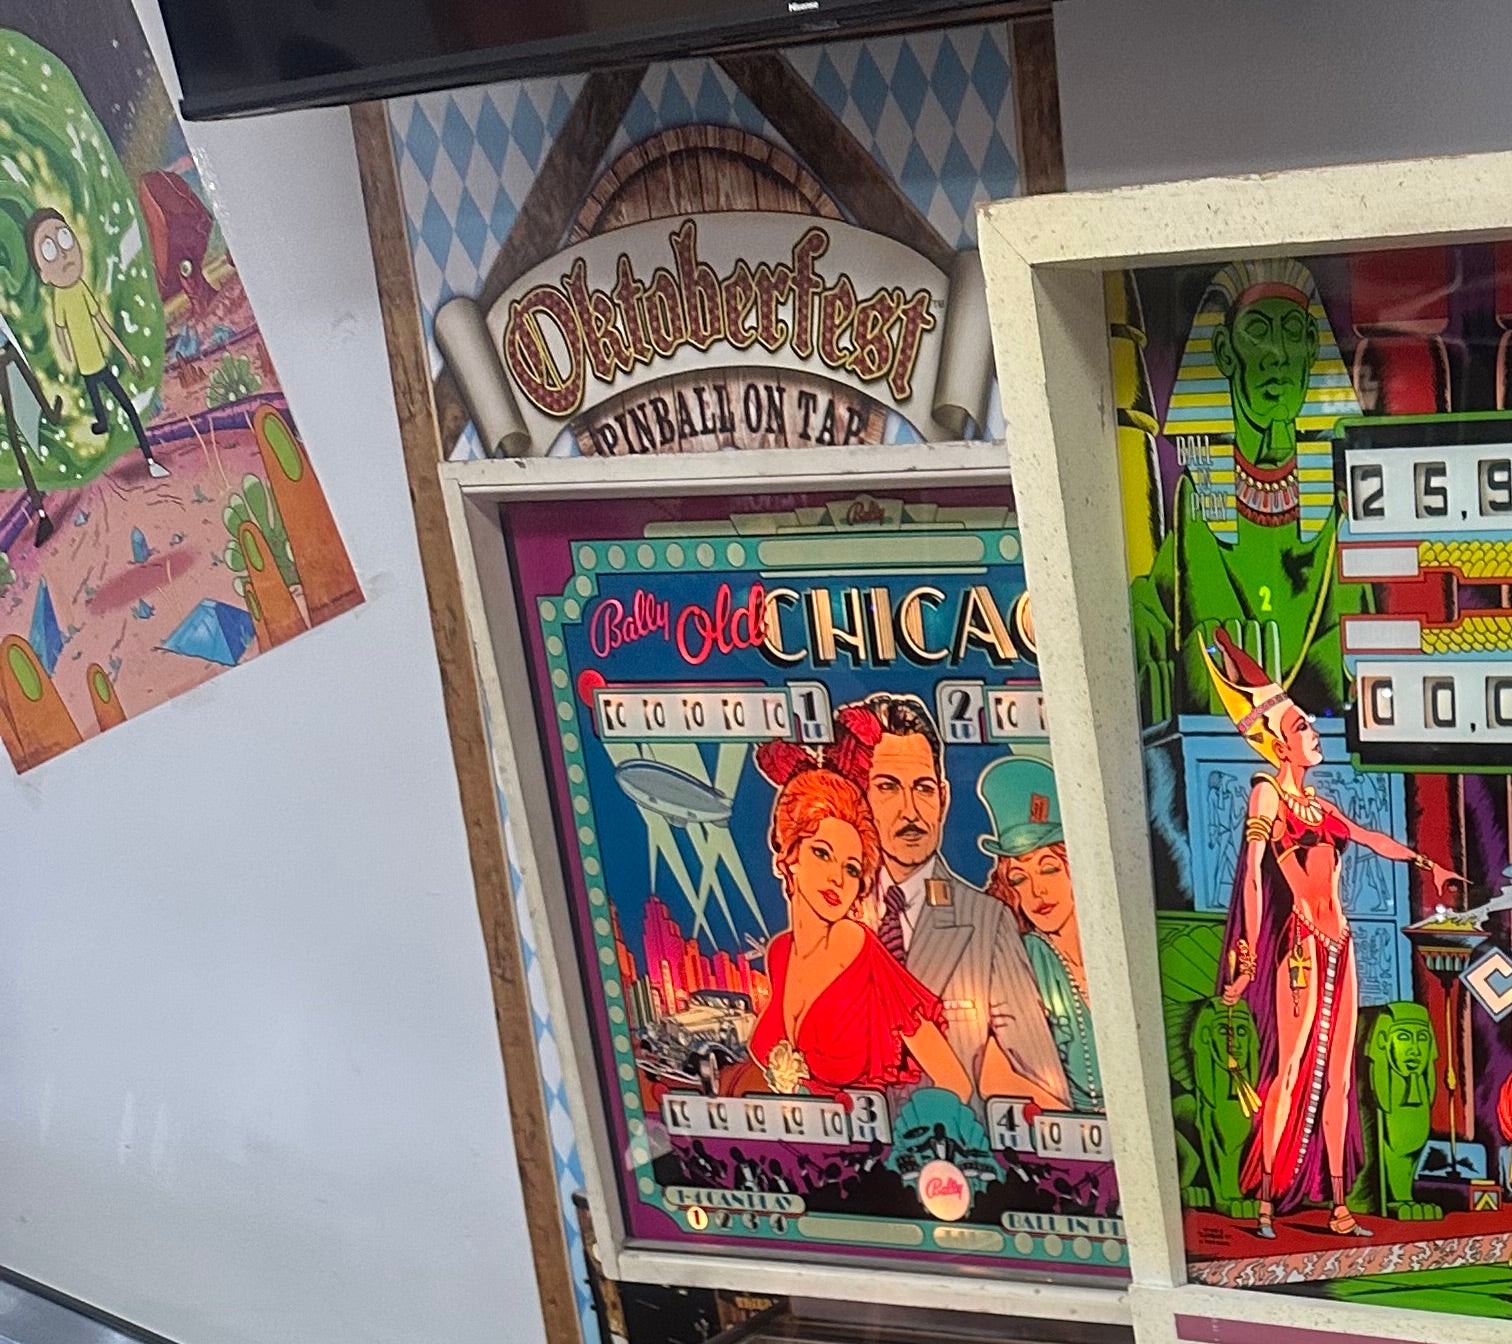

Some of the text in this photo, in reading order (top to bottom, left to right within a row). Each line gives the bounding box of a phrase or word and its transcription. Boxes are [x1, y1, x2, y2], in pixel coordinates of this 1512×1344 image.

[504, 219, 936, 416] Oktoberfest
[596, 383, 867, 456] PINBALL ON TAP
[590, 588, 671, 658] Bally
[676, 582, 768, 666] Old
[800, 690, 819, 722] 1
[950, 689, 974, 722] 2
[857, 1095, 878, 1123] 3
[997, 1104, 1019, 1132] 4
[926, 1176, 964, 1199] Bally
[693, 1209, 787, 1233] 1 2 3 4
[1007, 1212, 1090, 1235] BALL IN
